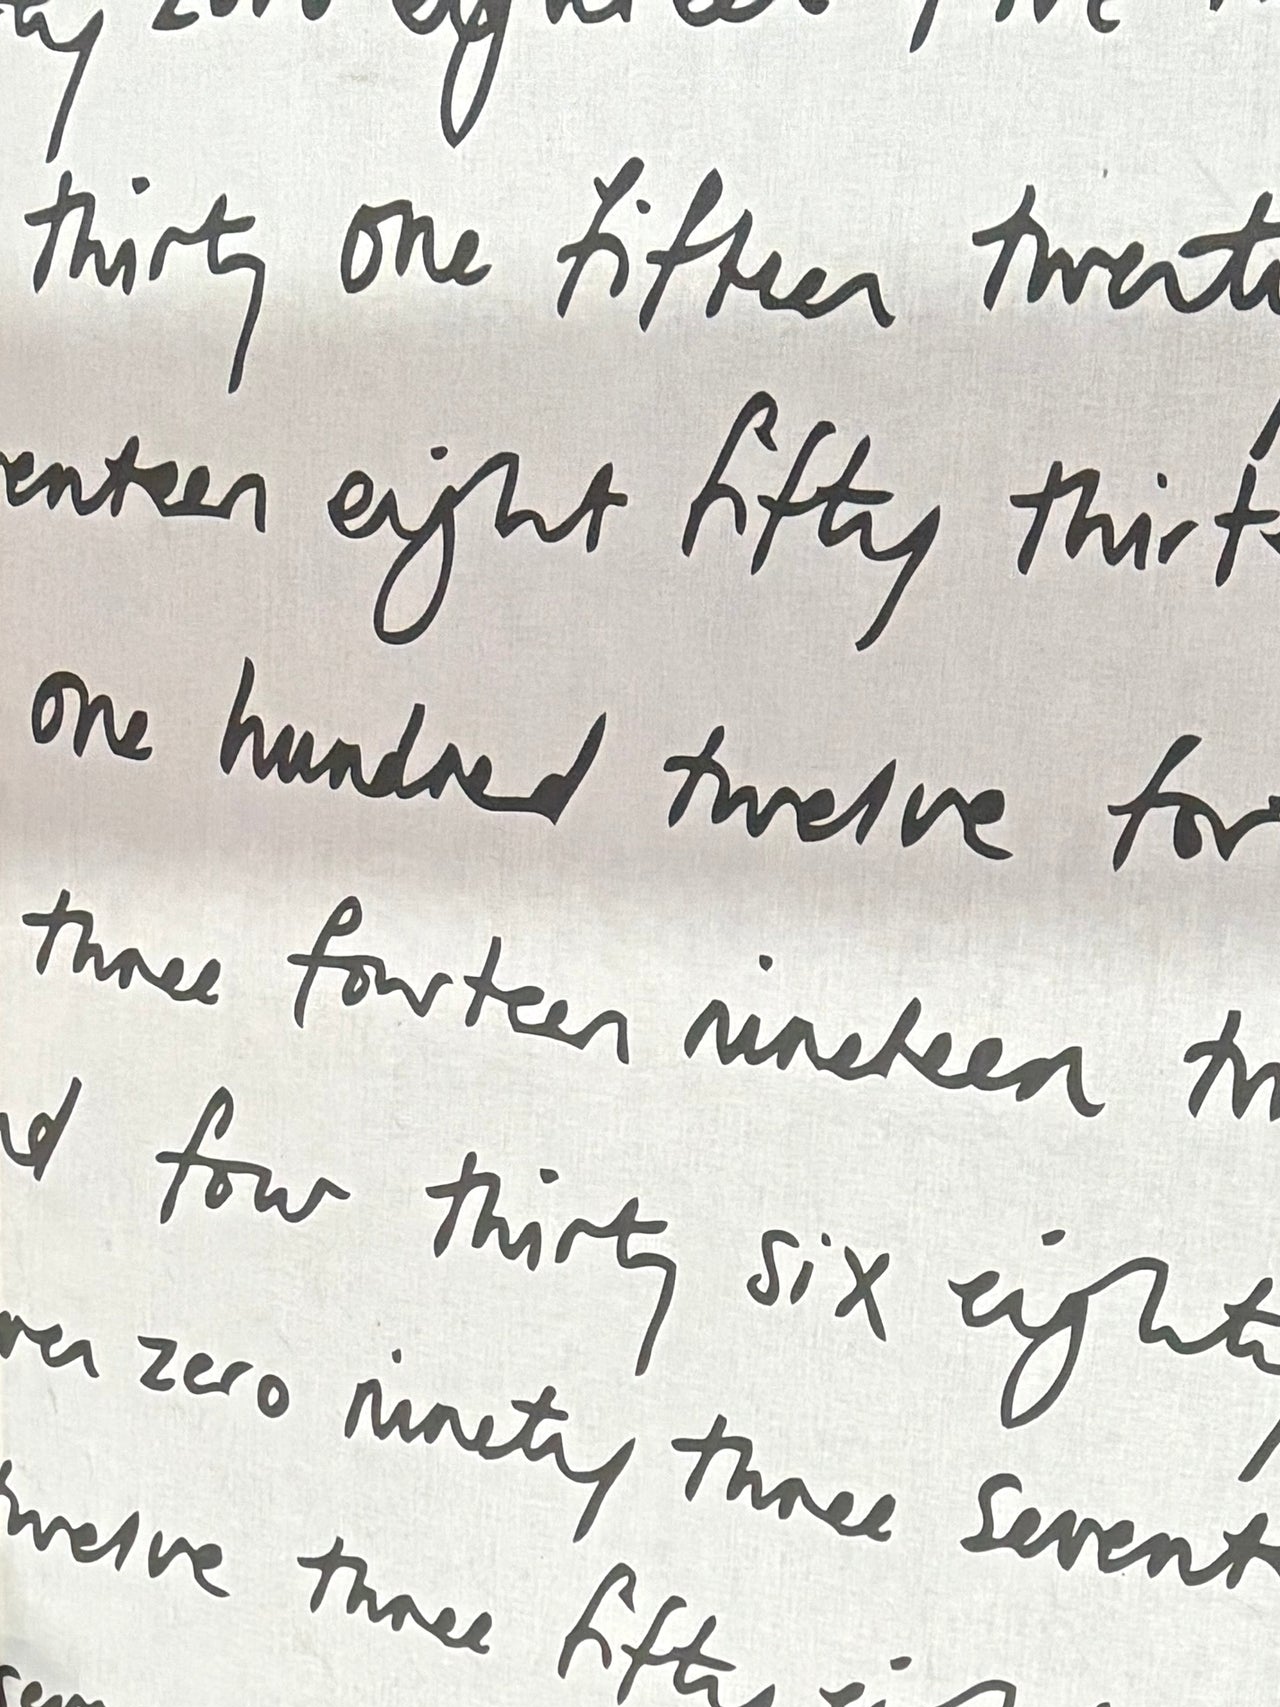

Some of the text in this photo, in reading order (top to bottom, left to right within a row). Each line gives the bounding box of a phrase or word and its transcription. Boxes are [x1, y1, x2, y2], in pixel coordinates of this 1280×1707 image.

[23, 169, 267, 395] thirty
[339, 198, 493, 295] one
[555, 156, 897, 334] fifteen
[326, 445, 629, 647] eight
[680, 389, 942, 653] fifty
[30, 669, 154, 762] one
[218, 655, 608, 827] hundred
[662, 724, 1014, 862] twelve
[20, 888, 222, 1006] three
[286, 894, 630, 1066] fourteen
[683, 955, 1107, 1119] nineteen
[154, 1085, 352, 1225] four
[424, 1150, 678, 1377] thirty
[745, 1228, 891, 1343] six
[136, 1334, 291, 1420] zero
[343, 1348, 637, 1544] ninety
[670, 1413, 897, 1543] three
[296, 1535, 493, 1656] three
